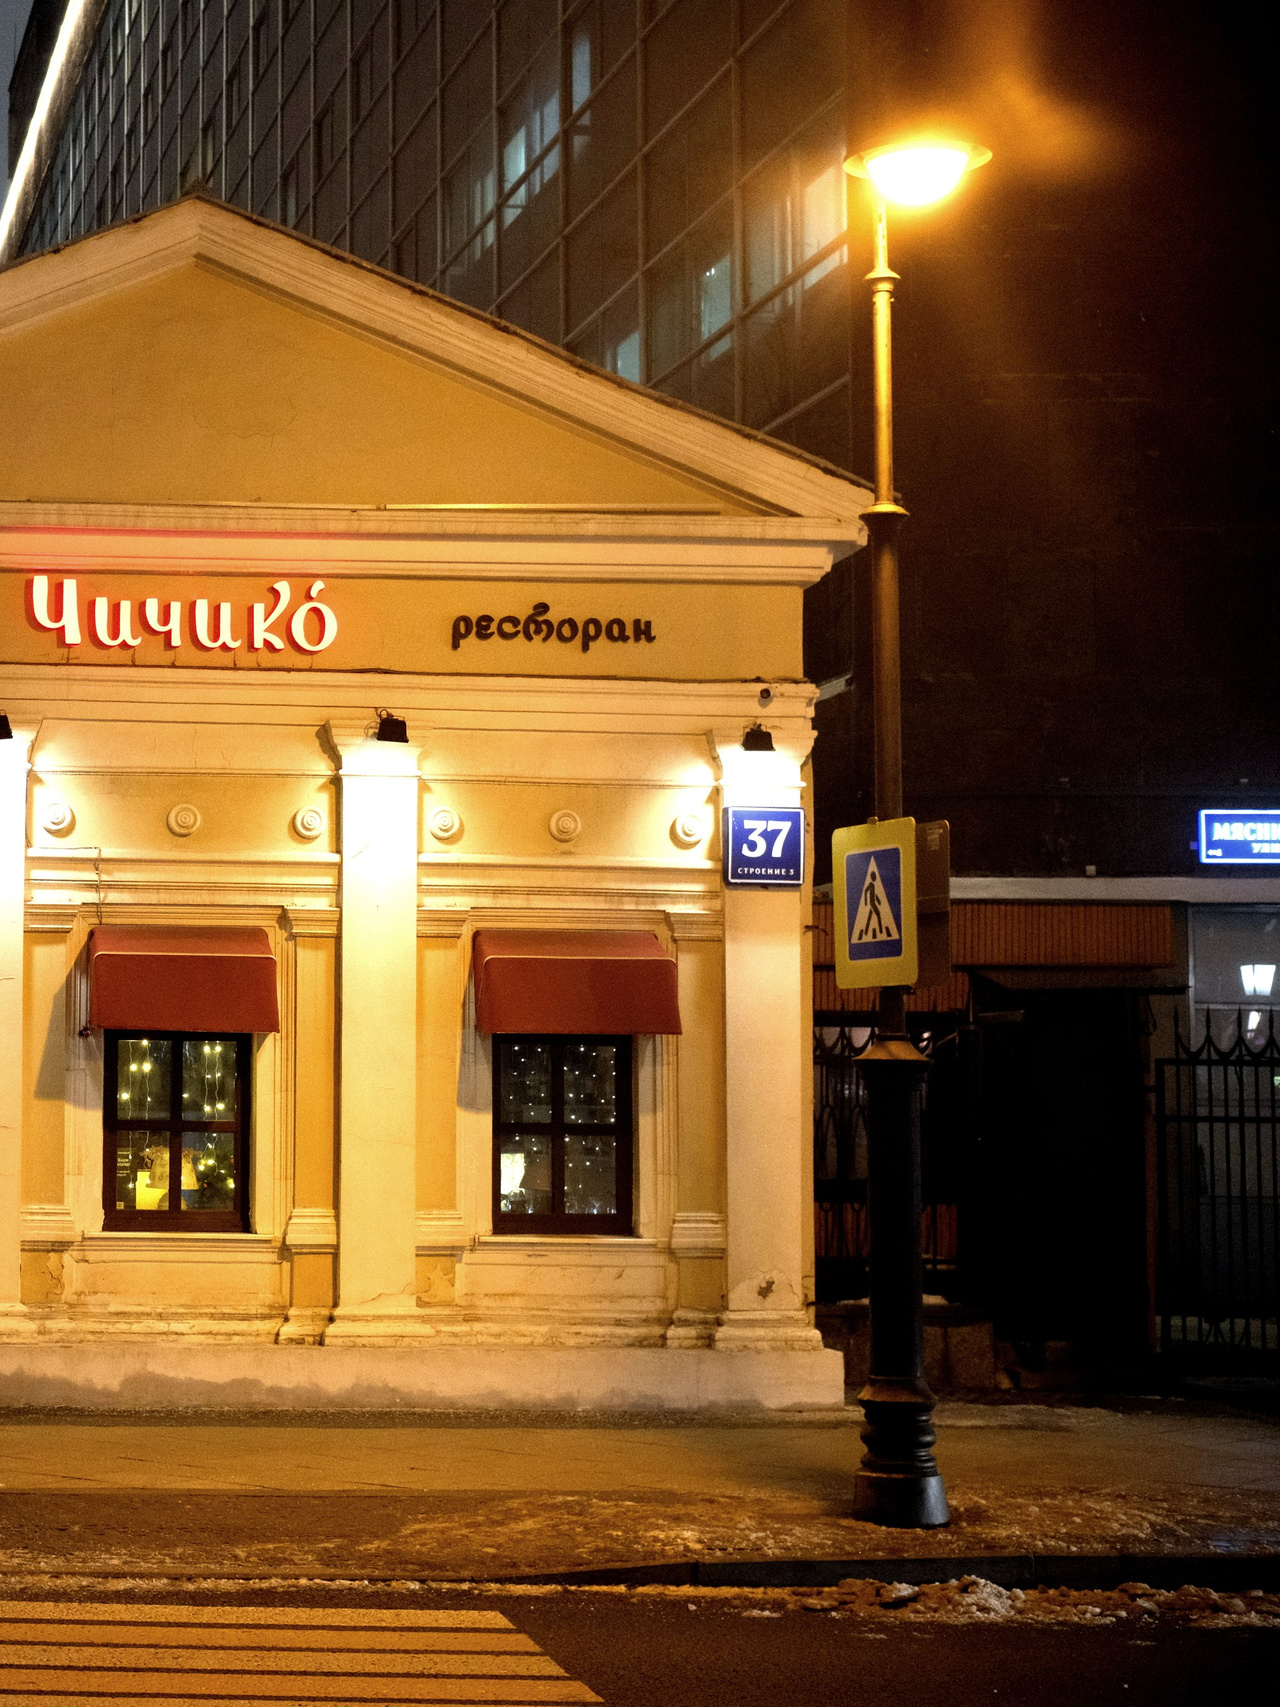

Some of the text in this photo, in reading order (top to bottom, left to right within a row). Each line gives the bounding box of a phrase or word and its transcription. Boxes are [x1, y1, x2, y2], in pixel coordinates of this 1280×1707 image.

[451, 602, 656, 652] ресторан
[742, 820, 792, 858] 37
[737, 867, 786, 875] СТРОЕНИЕ
